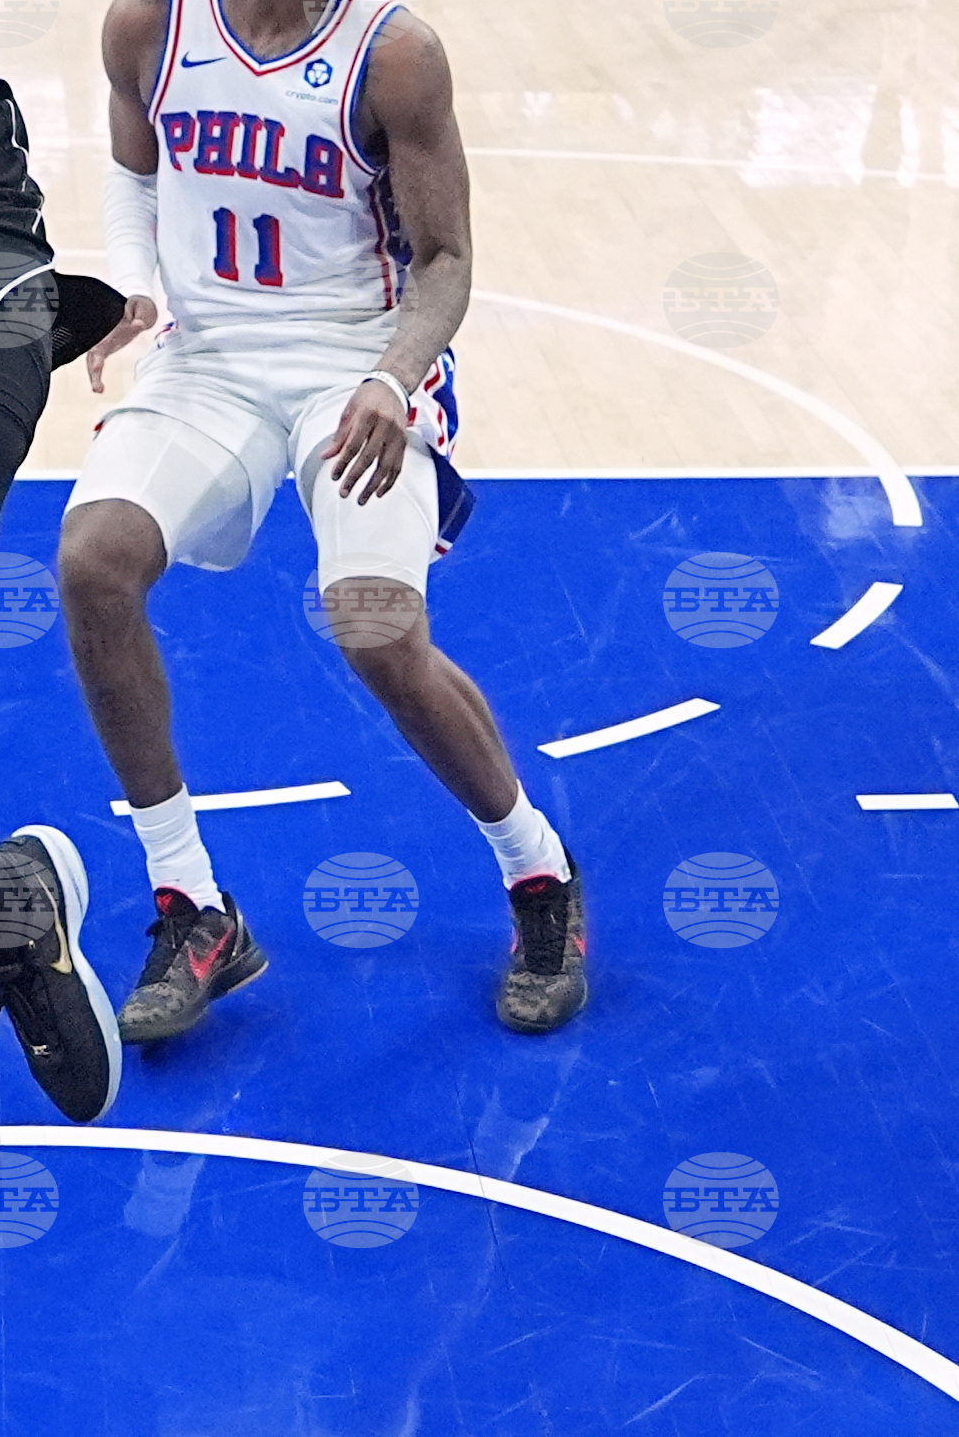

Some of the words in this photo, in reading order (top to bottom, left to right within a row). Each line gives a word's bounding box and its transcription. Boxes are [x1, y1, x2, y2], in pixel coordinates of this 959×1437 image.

[285, 89, 339, 106] crypto.com
[160, 109, 345, 199] PHILA
[212, 206, 283, 287] 11
